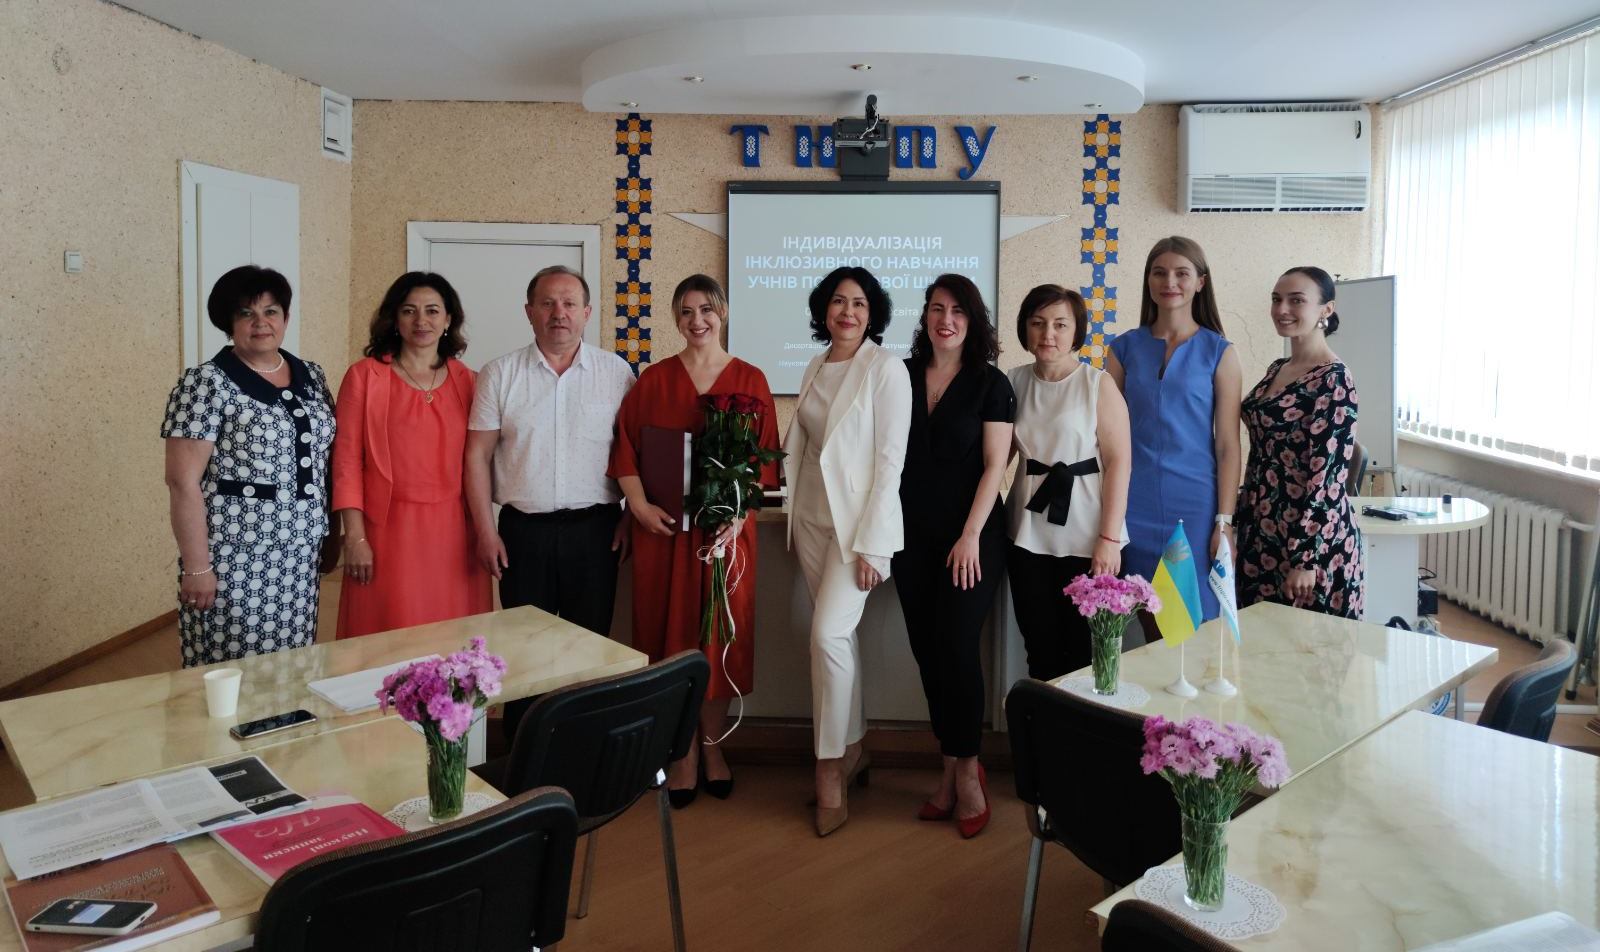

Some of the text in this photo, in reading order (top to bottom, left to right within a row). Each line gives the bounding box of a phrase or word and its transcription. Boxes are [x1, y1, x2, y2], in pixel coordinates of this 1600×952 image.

[729, 124, 997, 180] ТНПУ
[782, 236, 943, 253] ІНДИВІДУАЛІЗАЦІЯ
[745, 256, 980, 269] ІНКЛЮЗИВНОГО НАВЧАННЯ
[747, 276, 799, 289] УЧНІВ
